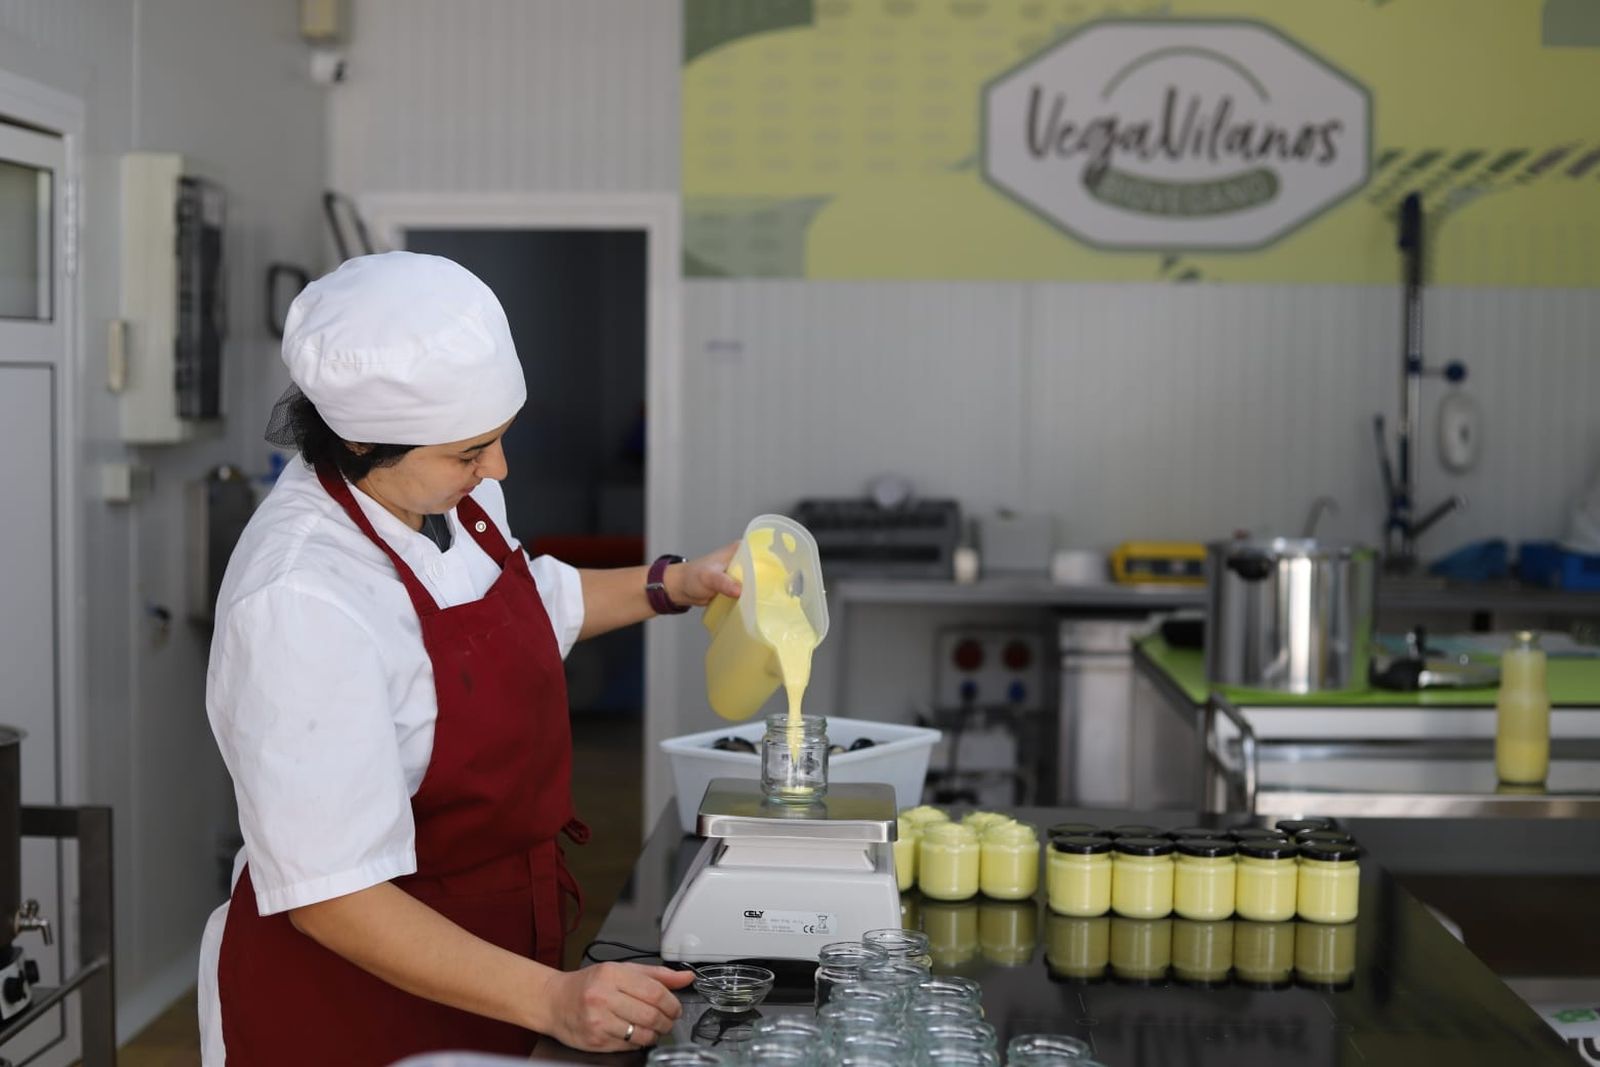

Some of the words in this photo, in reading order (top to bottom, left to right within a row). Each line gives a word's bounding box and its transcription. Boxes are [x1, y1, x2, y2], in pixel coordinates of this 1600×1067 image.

[1026, 84, 1344, 187] VegaVilanos
[744, 910, 764, 918] CELY
[803, 925, 815, 934] CE
